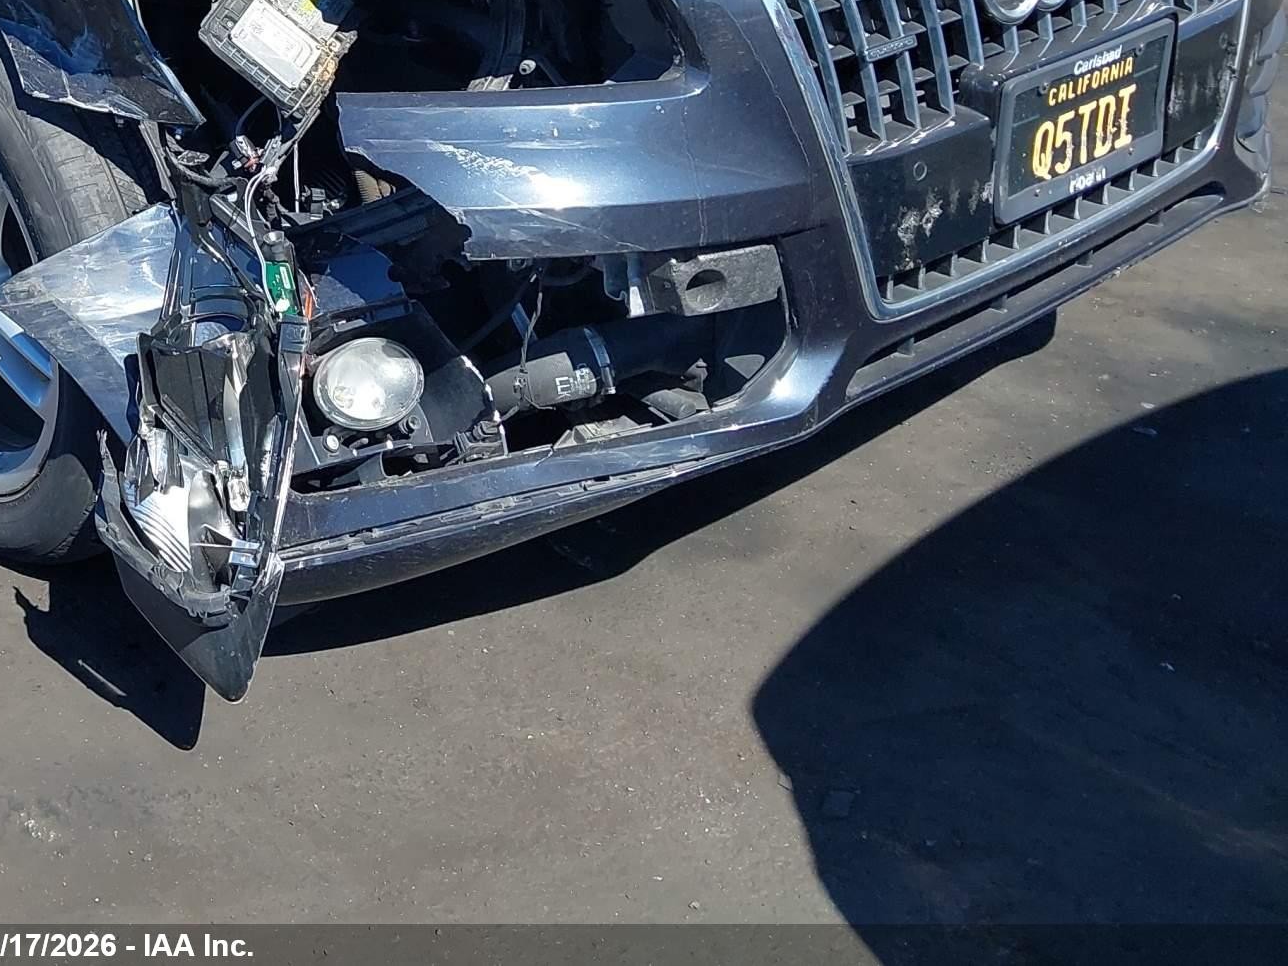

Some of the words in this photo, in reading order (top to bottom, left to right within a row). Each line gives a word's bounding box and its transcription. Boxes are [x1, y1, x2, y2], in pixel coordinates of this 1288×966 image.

[1048, 56, 1134, 107] CALIFORNIA
[1073, 45, 1123, 75] Carlsbad
[1032, 83, 1137, 181] Q5TDI
